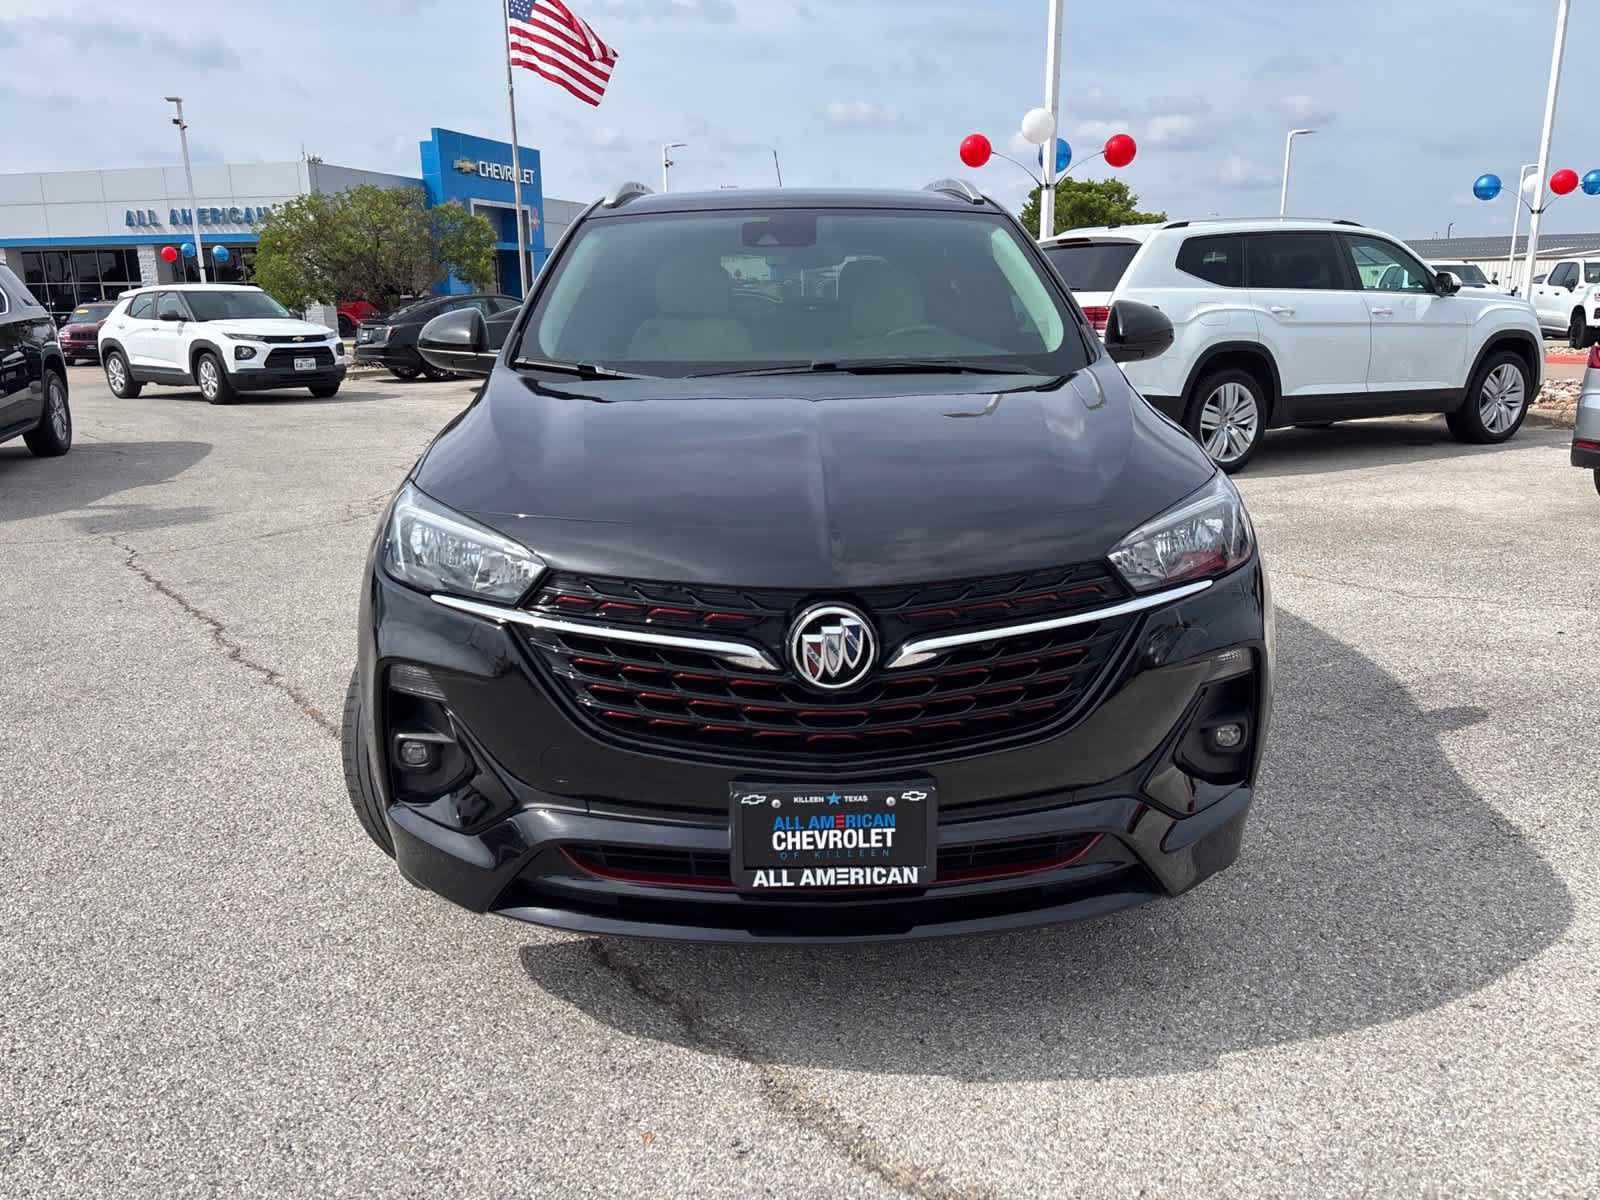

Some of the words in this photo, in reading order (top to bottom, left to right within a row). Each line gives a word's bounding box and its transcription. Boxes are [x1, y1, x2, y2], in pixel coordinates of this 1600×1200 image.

[479, 160, 535, 185] CHEVRLET
[125, 209, 161, 227] ALL
[793, 796, 825, 804] KILLEEN
[843, 795, 868, 803] TEXAS
[773, 815, 804, 830] ALL
[808, 813, 896, 830] AMERICAN
[772, 828, 896, 851] CHEVROLET
[780, 851, 799, 860] OF
[814, 849, 889, 859] KILLEEN
[752, 869, 795, 888] ALL
[799, 866, 919, 886] AMERICAN
